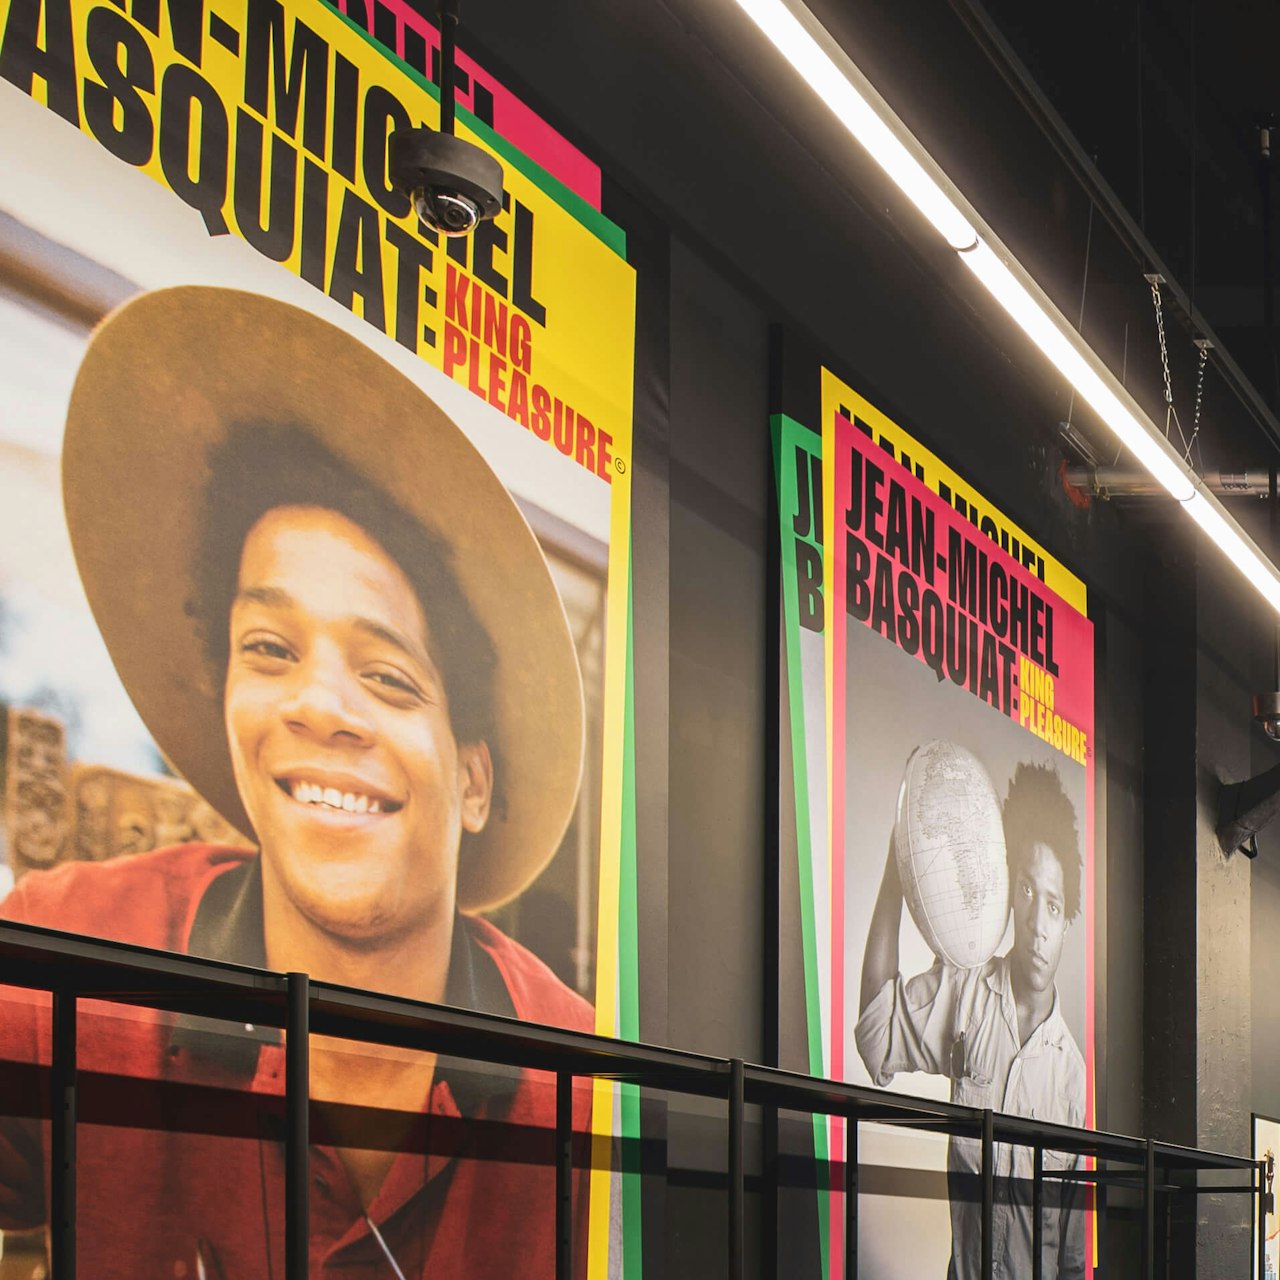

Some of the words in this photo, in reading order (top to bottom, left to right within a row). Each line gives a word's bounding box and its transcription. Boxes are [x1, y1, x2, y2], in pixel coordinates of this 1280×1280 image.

[0, 0, 437, 355] ASQUIAT:
[446, 263, 532, 371] KING
[845, 446, 1059, 678] JEAN-MICHEL
[845, 530, 1019, 718] BASQUIAT:
[1020, 655, 1055, 712] KING
